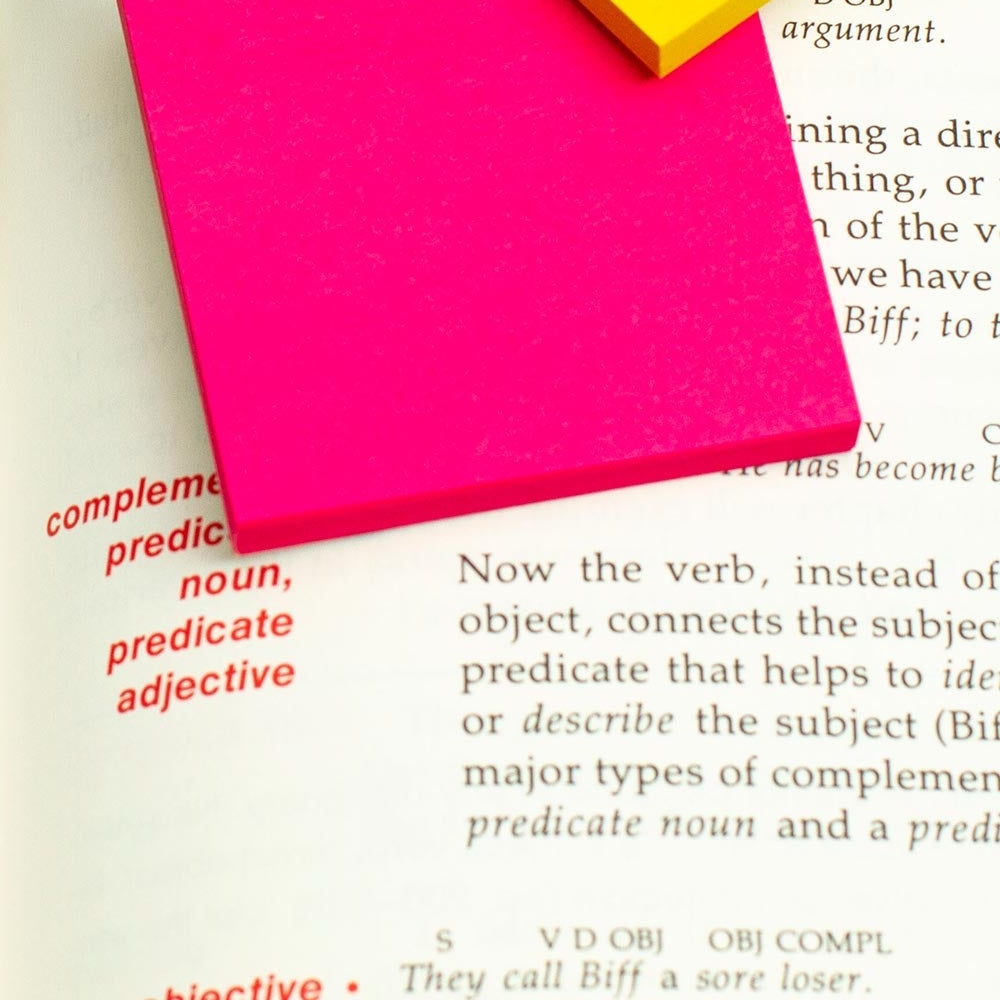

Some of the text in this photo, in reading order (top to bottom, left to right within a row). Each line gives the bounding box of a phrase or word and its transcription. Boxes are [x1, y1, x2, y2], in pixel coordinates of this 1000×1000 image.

[781, 20, 945, 50] argument.
[811, 161, 985, 204] thing, or
[846, 209, 959, 243] of the
[830, 258, 992, 292] we have
[843, 304, 920, 346] Biff;
[855, 451, 975, 482] become
[179, 563, 292, 601] noun,
[459, 551, 937, 589] Now the verb, instead
[106, 608, 294, 676] predicate
[459, 603, 783, 643] object, connects
[116, 659, 296, 714] adjective
[461, 652, 869, 697] predicate that helps
[522, 702, 916, 746] describe subject
[463, 755, 703, 796] major types
[467, 805, 850, 848] predicate noun and
[708, 928, 892, 954] OBJ COMPL
[400, 961, 872, 999] They call Biff sore loser.
